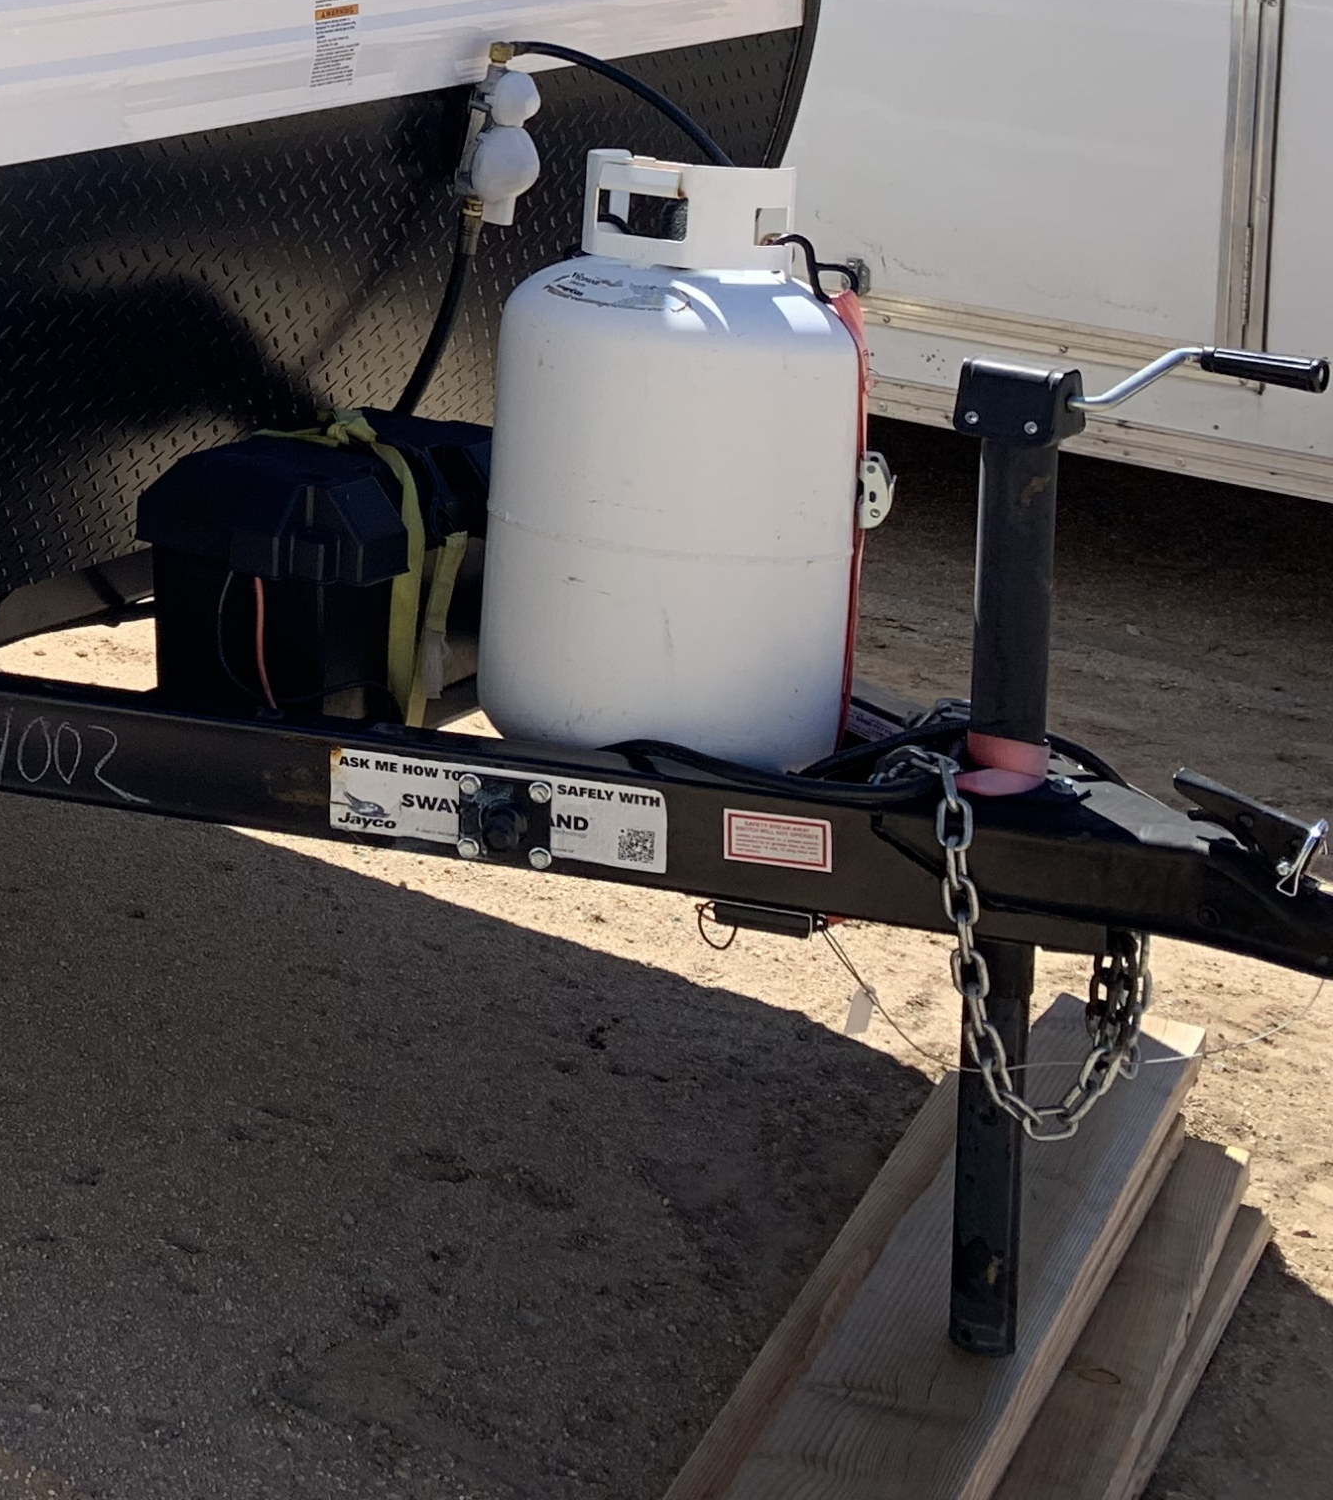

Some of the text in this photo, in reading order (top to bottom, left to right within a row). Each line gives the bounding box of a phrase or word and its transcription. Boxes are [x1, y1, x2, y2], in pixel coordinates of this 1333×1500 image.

[339, 756, 460, 782] ASK ME HOW TO
[557, 784, 661, 808] SAFELY WITH
[338, 812, 397, 830] Jayco
